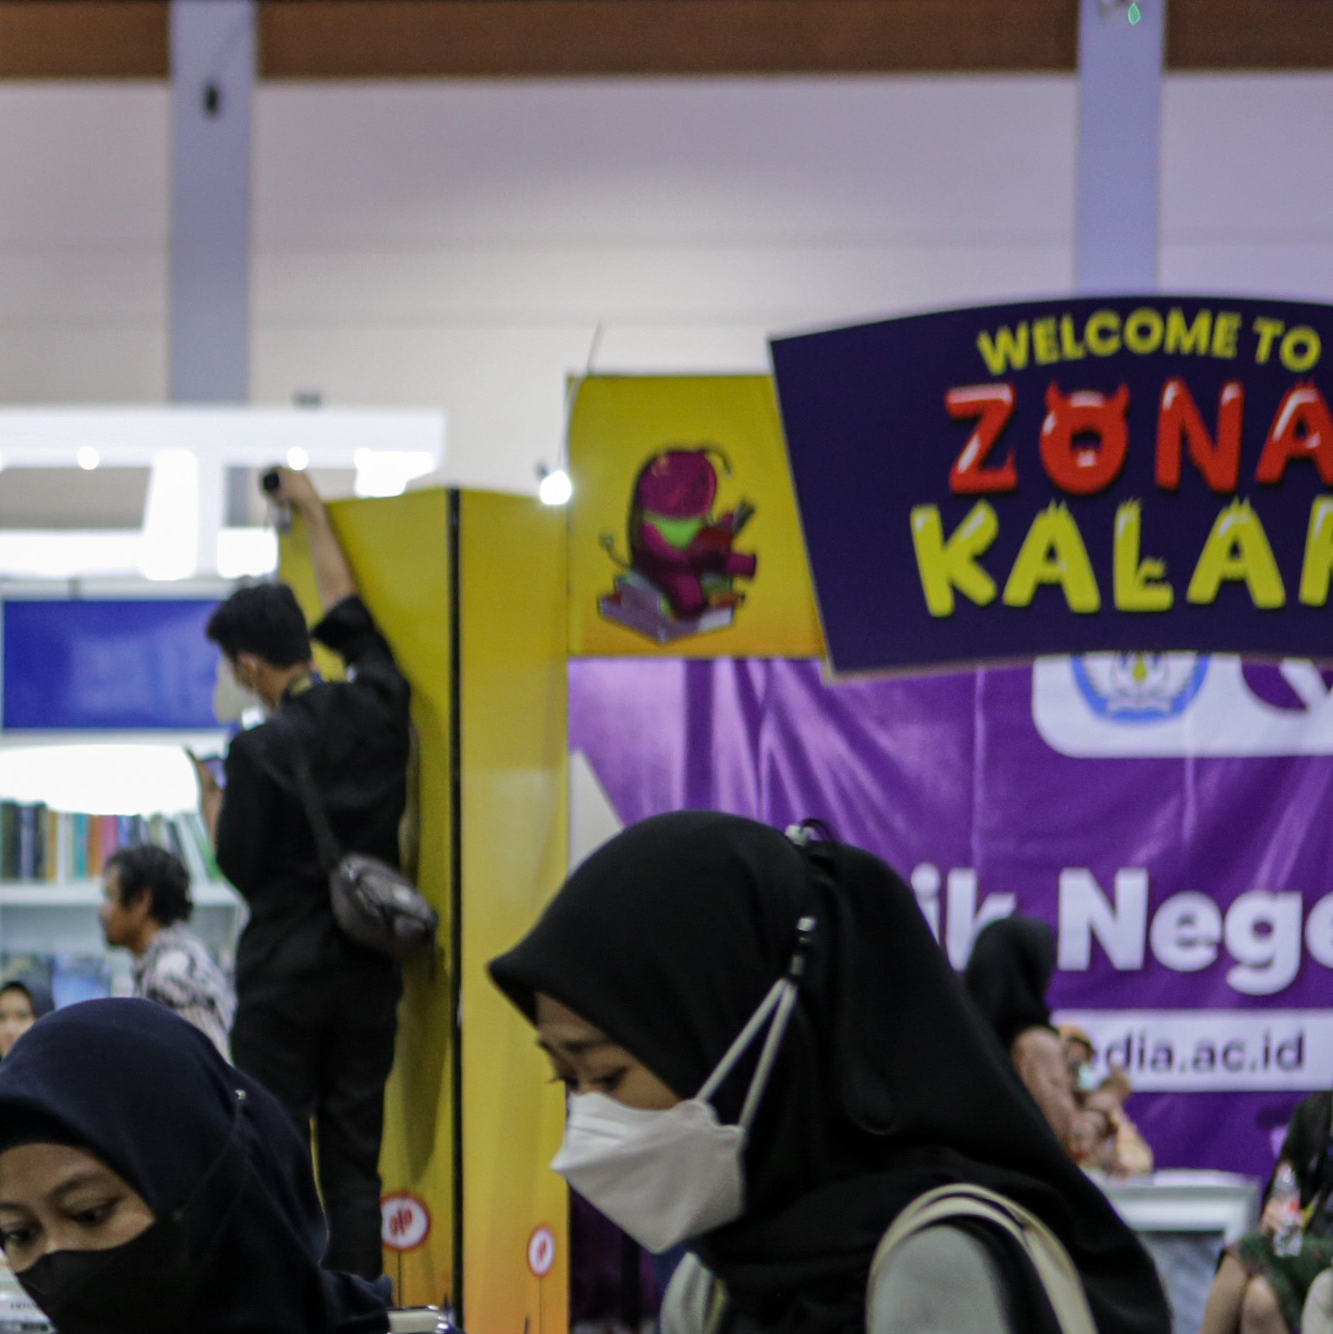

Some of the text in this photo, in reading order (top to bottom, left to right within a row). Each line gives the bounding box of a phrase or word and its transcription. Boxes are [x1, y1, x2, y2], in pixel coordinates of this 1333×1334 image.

[976, 308, 1322, 376] WELCOME TO
[944, 378, 1333, 493] ZONA
[1093, 1030, 1306, 1074] dia.ac.id
